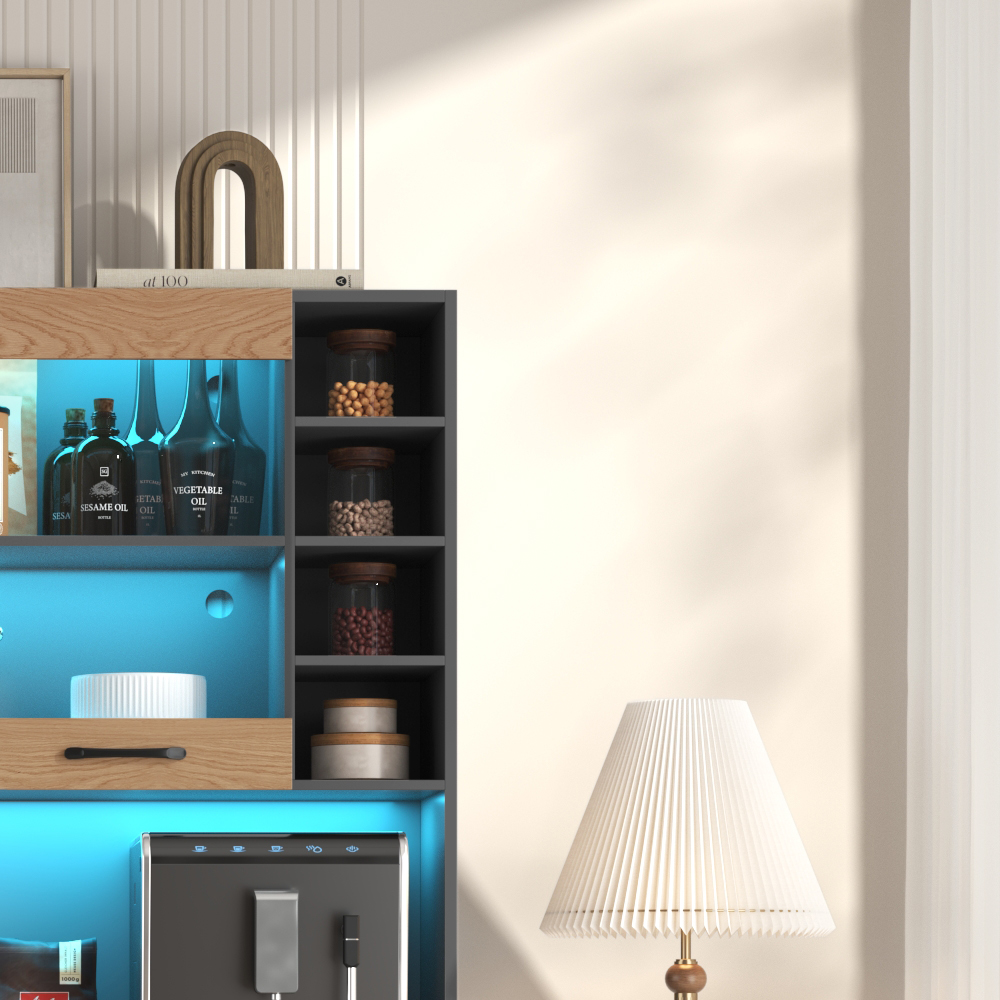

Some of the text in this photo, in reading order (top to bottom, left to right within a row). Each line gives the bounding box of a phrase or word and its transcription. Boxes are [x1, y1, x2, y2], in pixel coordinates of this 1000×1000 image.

[143, 276, 188, 288] at 100
[191, 470, 215, 478] KITCHEN
[173, 486, 223, 495] VEGETABLE
[190, 497, 207, 506] OIL
[230, 495, 254, 503] TABLE
[80, 503, 129, 512] SESAME OIL
[139, 506, 155, 514] OIL
[230, 506, 239, 514] IL
[52, 512, 71, 520] SESA
